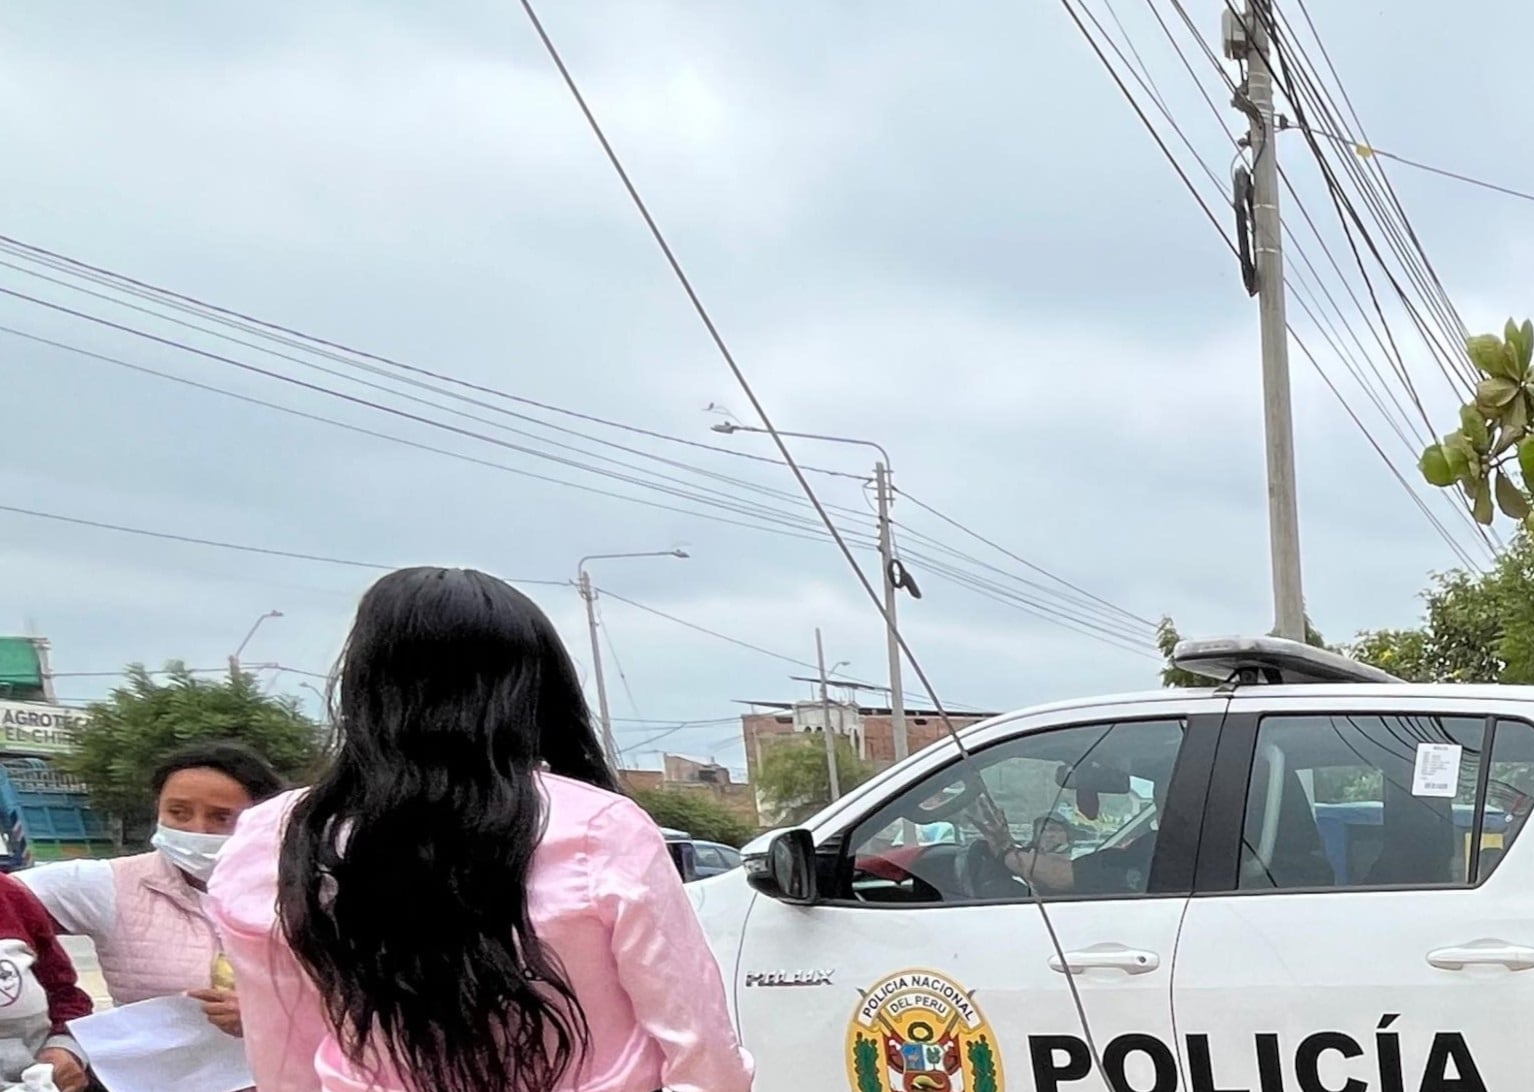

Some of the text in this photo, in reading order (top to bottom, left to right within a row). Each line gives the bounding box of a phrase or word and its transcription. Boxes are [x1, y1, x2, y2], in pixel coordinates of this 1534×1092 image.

[862, 975, 975, 1021] POLICIA NACIONAL
[889, 995, 947, 1014] DEL PERU
